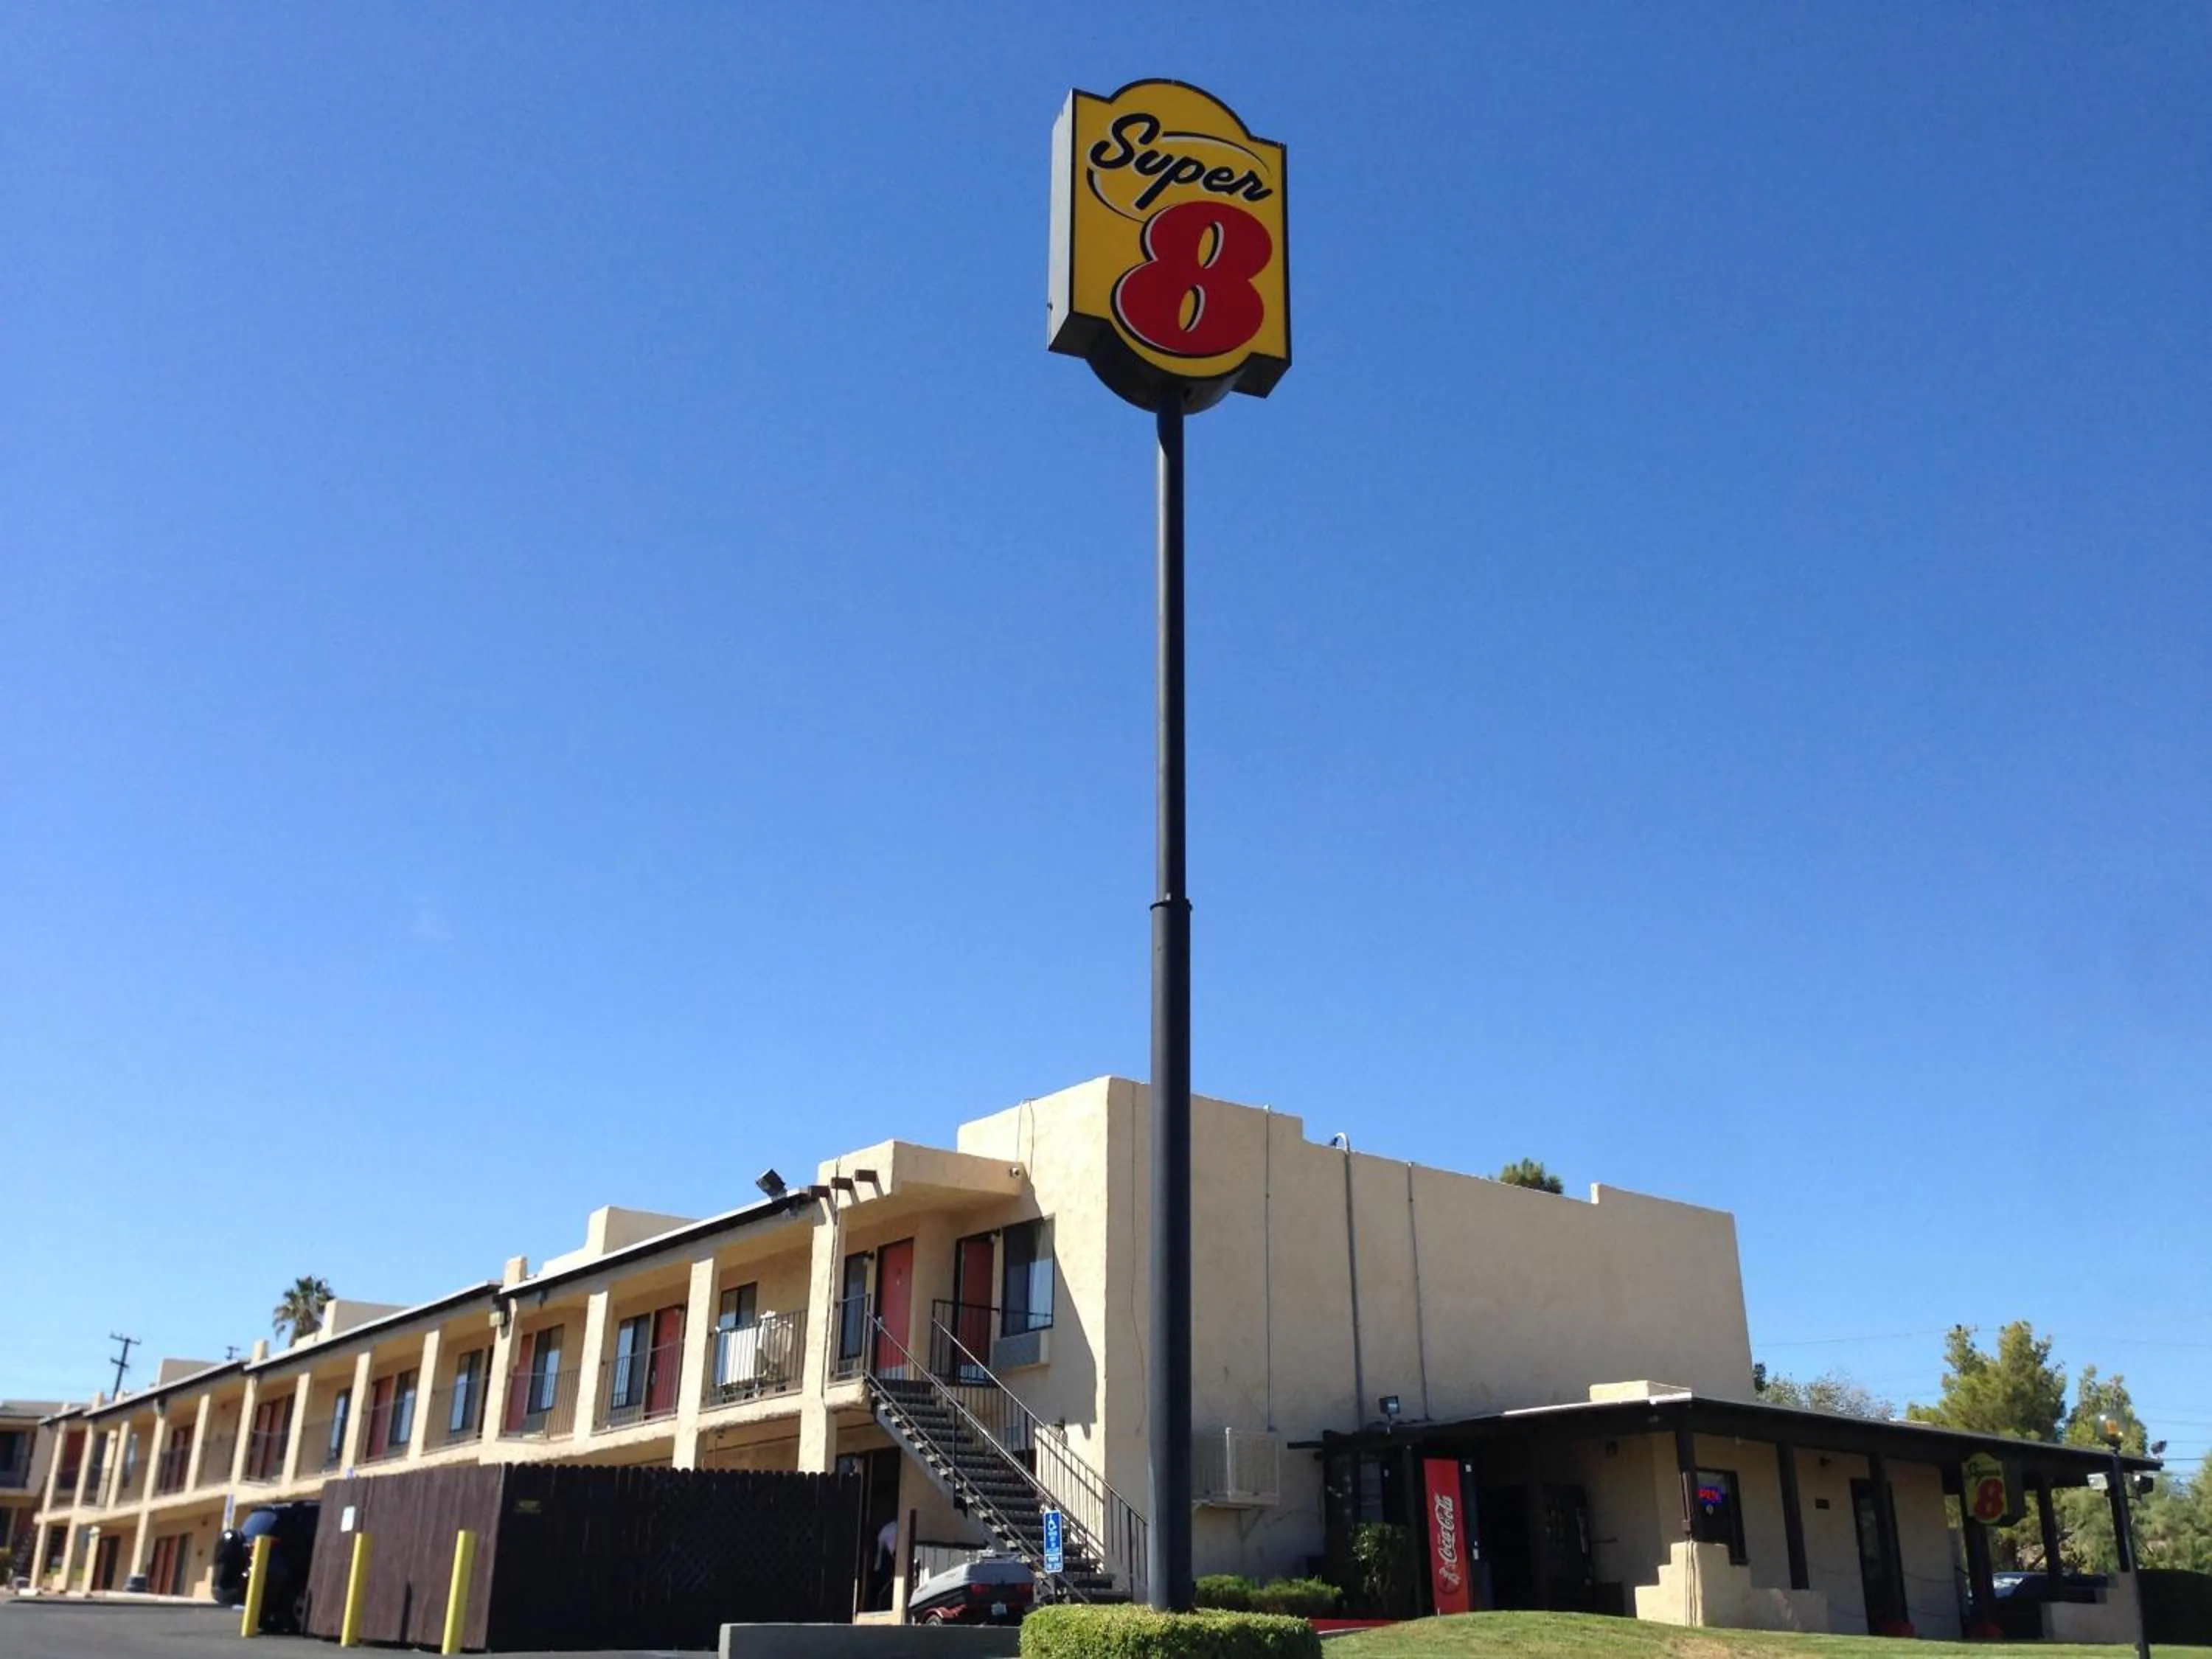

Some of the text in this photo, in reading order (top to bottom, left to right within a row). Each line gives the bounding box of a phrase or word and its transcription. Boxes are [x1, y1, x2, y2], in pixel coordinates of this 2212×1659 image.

[1090, 113, 1273, 210] Super
[1110, 201, 1273, 358] 8
[1974, 1477, 2004, 1519] 8
